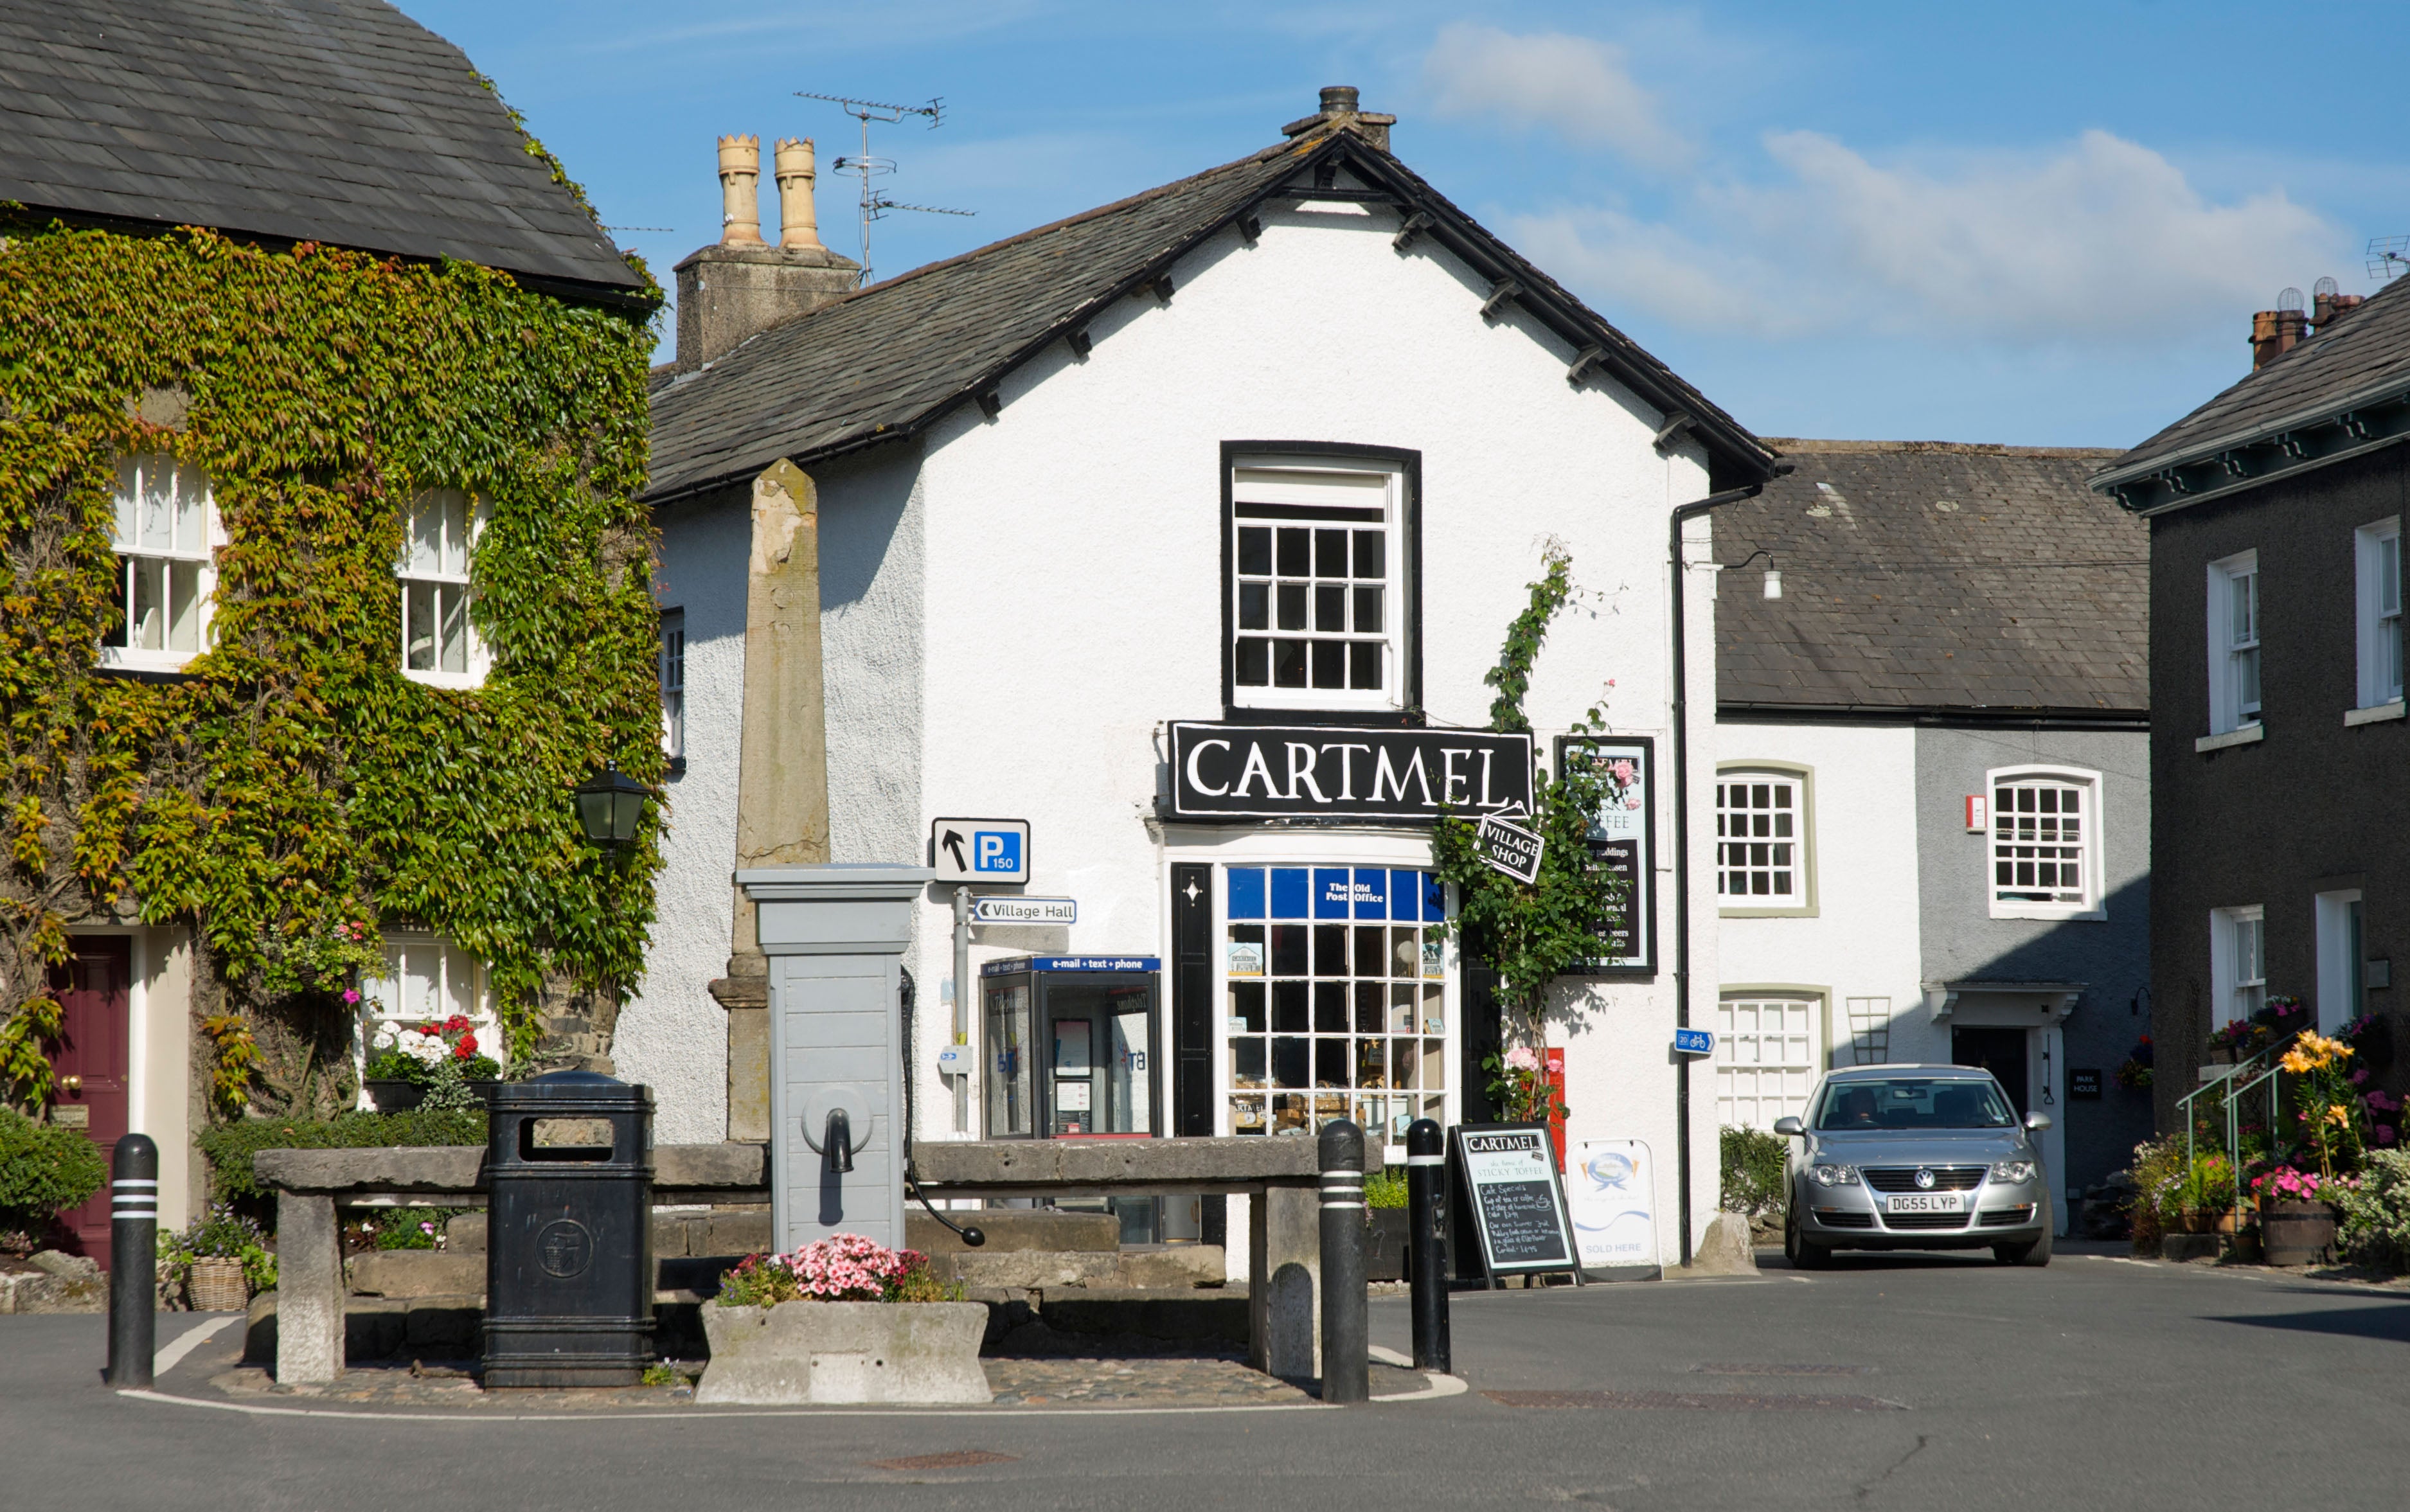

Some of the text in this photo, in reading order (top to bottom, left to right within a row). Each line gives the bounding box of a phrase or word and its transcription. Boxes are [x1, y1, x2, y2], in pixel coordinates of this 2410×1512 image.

[1186, 739, 1510, 808] CARTMEL
[1487, 824, 1539, 857] VILLAGE
[980, 835, 1013, 869] P 150
[1492, 844, 1527, 868] SHOP
[1596, 847, 1629, 858] puddings
[1329, 883, 1371, 893] The Old
[1326, 892, 1384, 902] Post Office
[993, 905, 1073, 919] Village Hall
[988, 961, 1026, 973] e-mail text phone
[1052, 959, 1080, 968] e-mail
[1088, 960, 1107, 968] text
[1114, 959, 1143, 970] phone
[1477, 1167, 1543, 1177] STICKY TOFFEE
[1893, 1197, 1957, 1210] DG55 LYP
[1585, 1243, 1642, 1254] SOLD HERE
